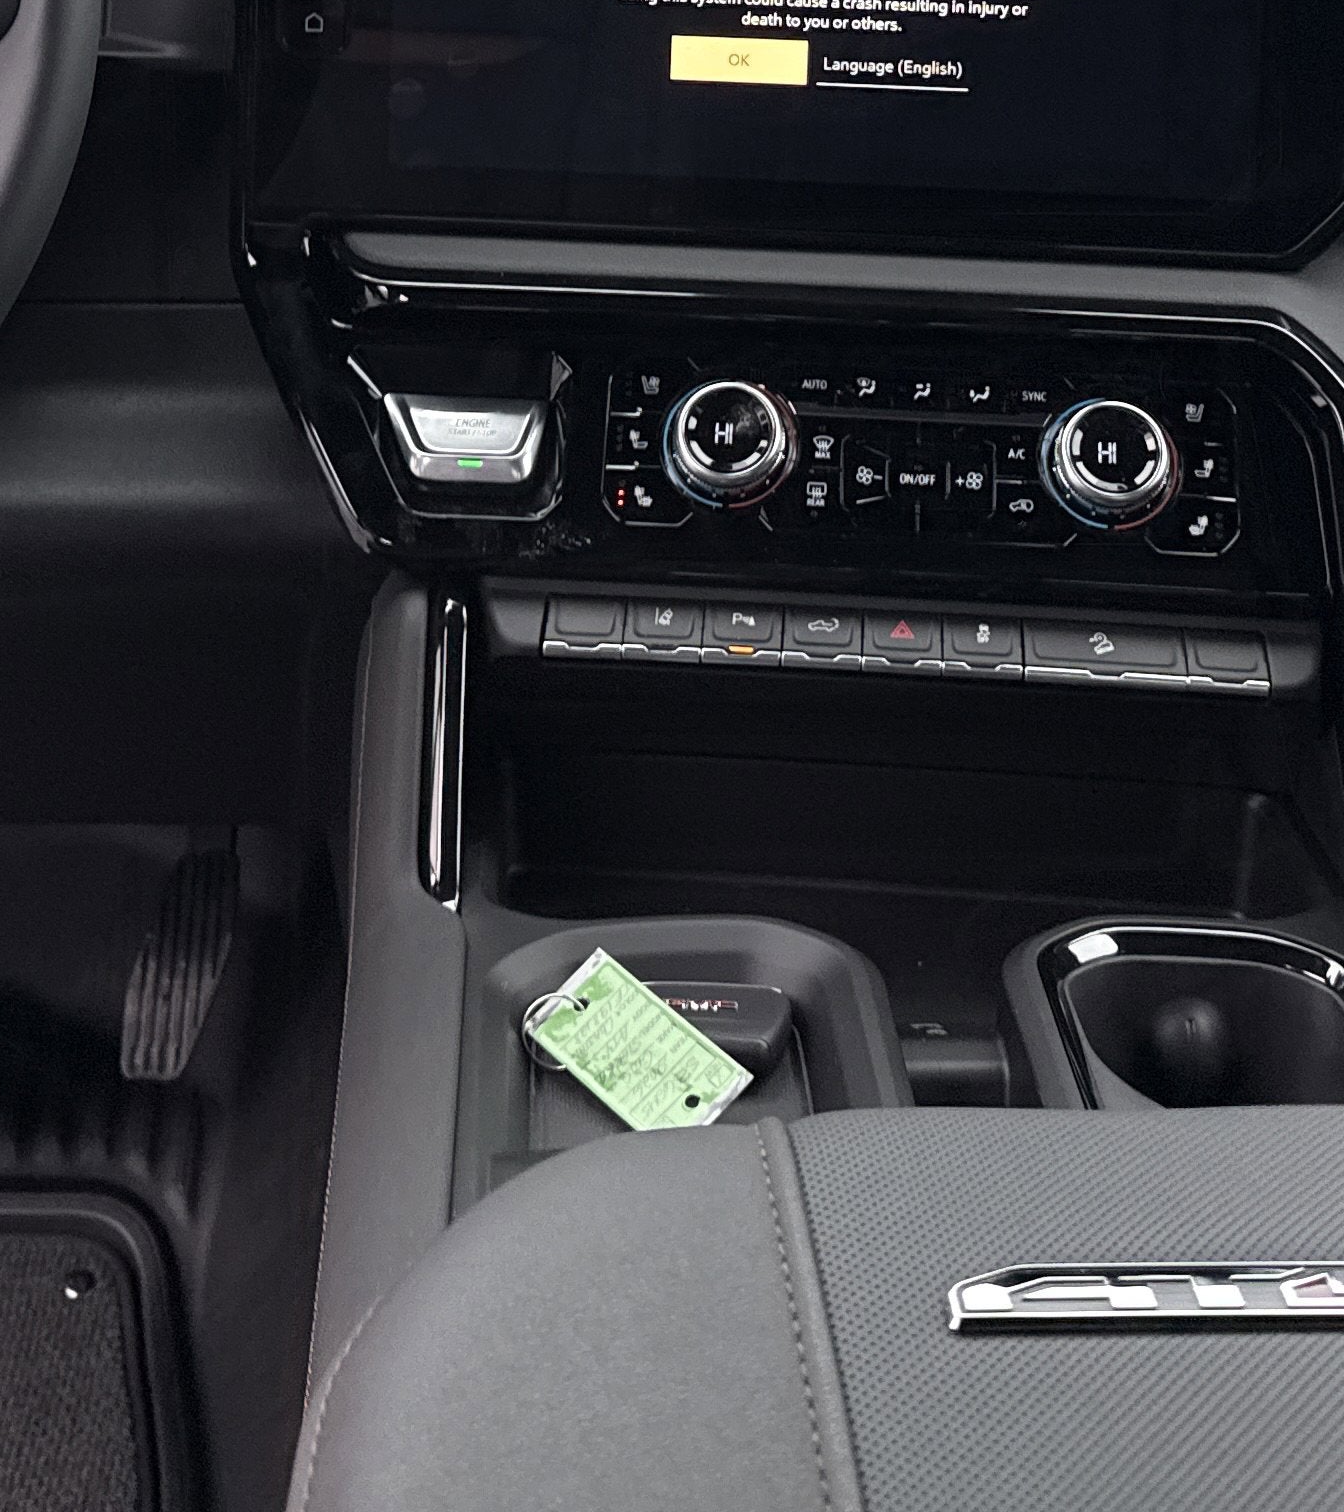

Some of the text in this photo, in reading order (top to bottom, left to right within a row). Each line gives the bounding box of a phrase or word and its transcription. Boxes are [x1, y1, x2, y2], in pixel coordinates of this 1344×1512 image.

[952, 0, 964, 13] in
[968, 0, 1009, 19] injury
[1012, 4, 1028, 16] or
[741, 11, 902, 32] death to you or others.
[728, 53, 750, 67] OK
[823, 57, 963, 79] Language (English)
[802, 379, 827, 389] AUTO
[1022, 391, 1047, 402] SYNC
[456, 418, 491, 428] ENGINE
[714, 422, 733, 445] HI
[815, 450, 831, 459] MAX
[1008, 448, 1025, 460] A/C
[1098, 442, 1117, 464] HI
[900, 473, 935, 486] ON/OFF
[807, 498, 824, 507] REAR
